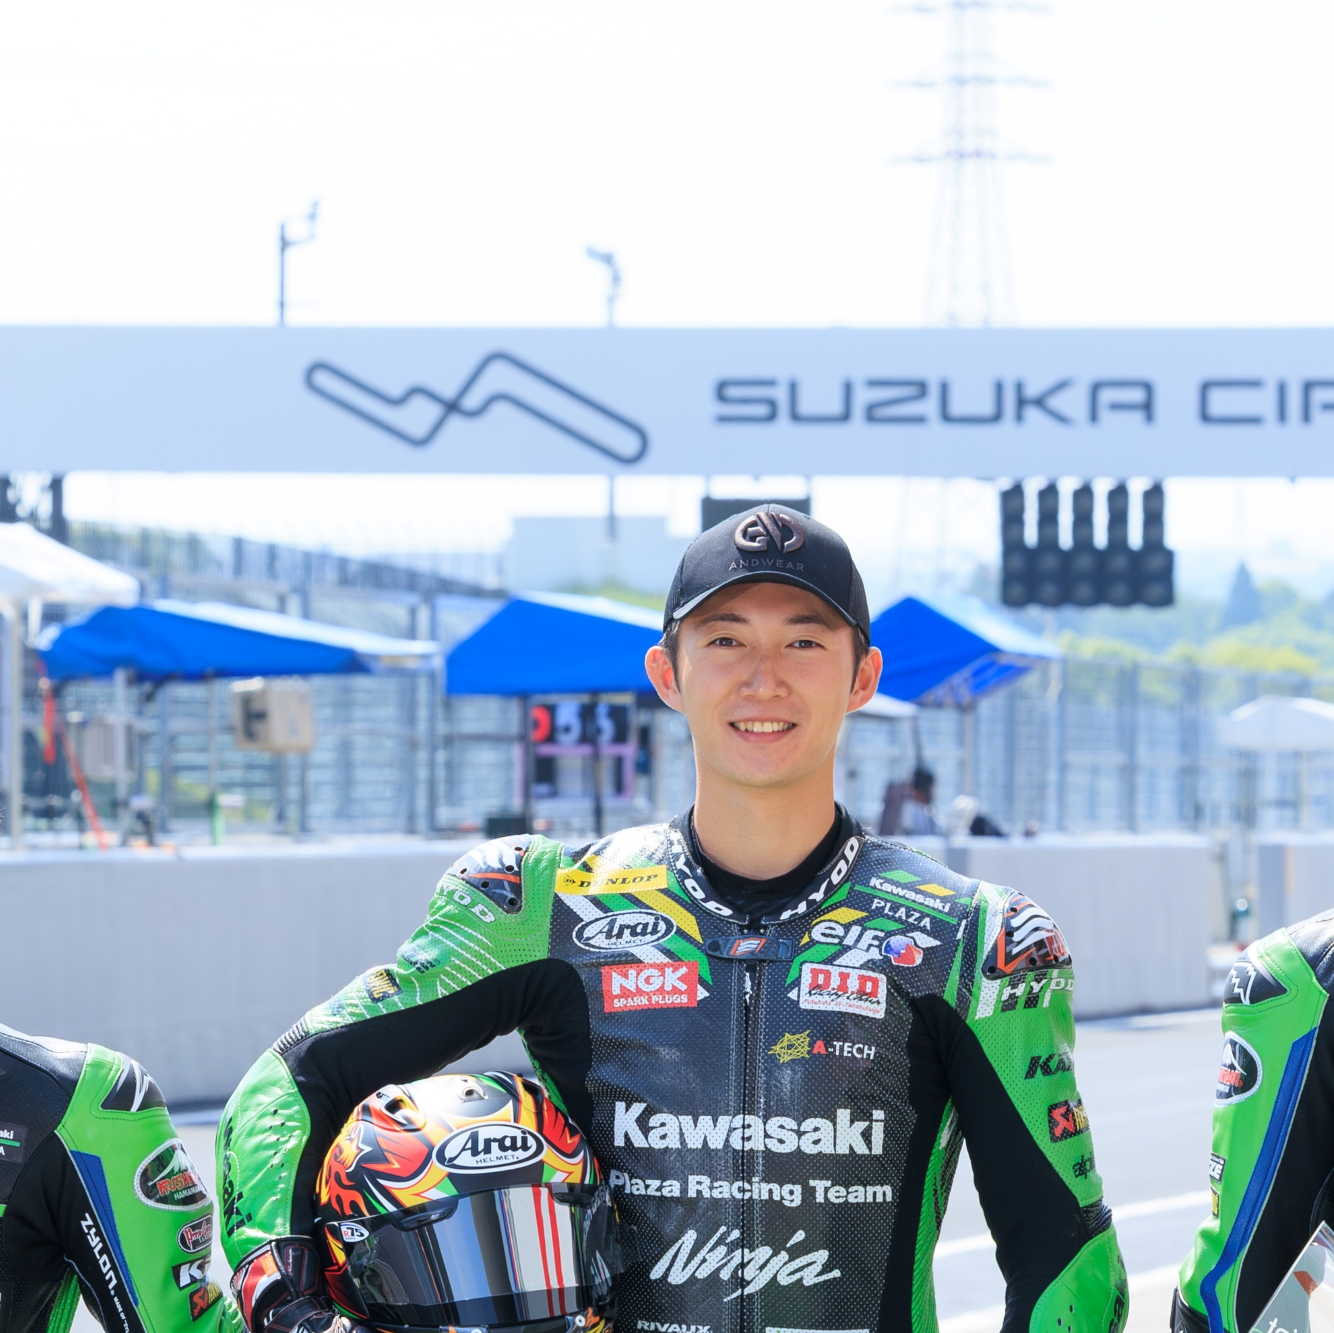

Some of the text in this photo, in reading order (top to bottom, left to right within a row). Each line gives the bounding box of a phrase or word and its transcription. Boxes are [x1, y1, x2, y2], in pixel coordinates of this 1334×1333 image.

[714, 377, 1155, 426] SUZUKA
[728, 557, 805, 573] ANDWEAR
[577, 873, 659, 889] DUNLOP
[779, 836, 861, 920] HYOD
[436, 883, 497, 924] YOD
[869, 877, 951, 912] Kawasaki
[582, 914, 662, 944] Arai
[870, 898, 932, 930] PLAZA
[810, 920, 885, 951] elf
[611, 965, 688, 996] NGK
[808, 967, 880, 999] D.I.D
[613, 993, 688, 1008] SPARK PLUGS
[812, 1039, 875, 1060] A-TECH
[614, 1101, 885, 1155] Kawasaki
[444, 1128, 532, 1165] Arai
[475, 1154, 517, 1165] HELMET
[609, 1169, 681, 1198] Plaza
[688, 1175, 802, 1207] Racing
[809, 1179, 893, 1204] Team
[650, 1225, 841, 1303] Ninja
